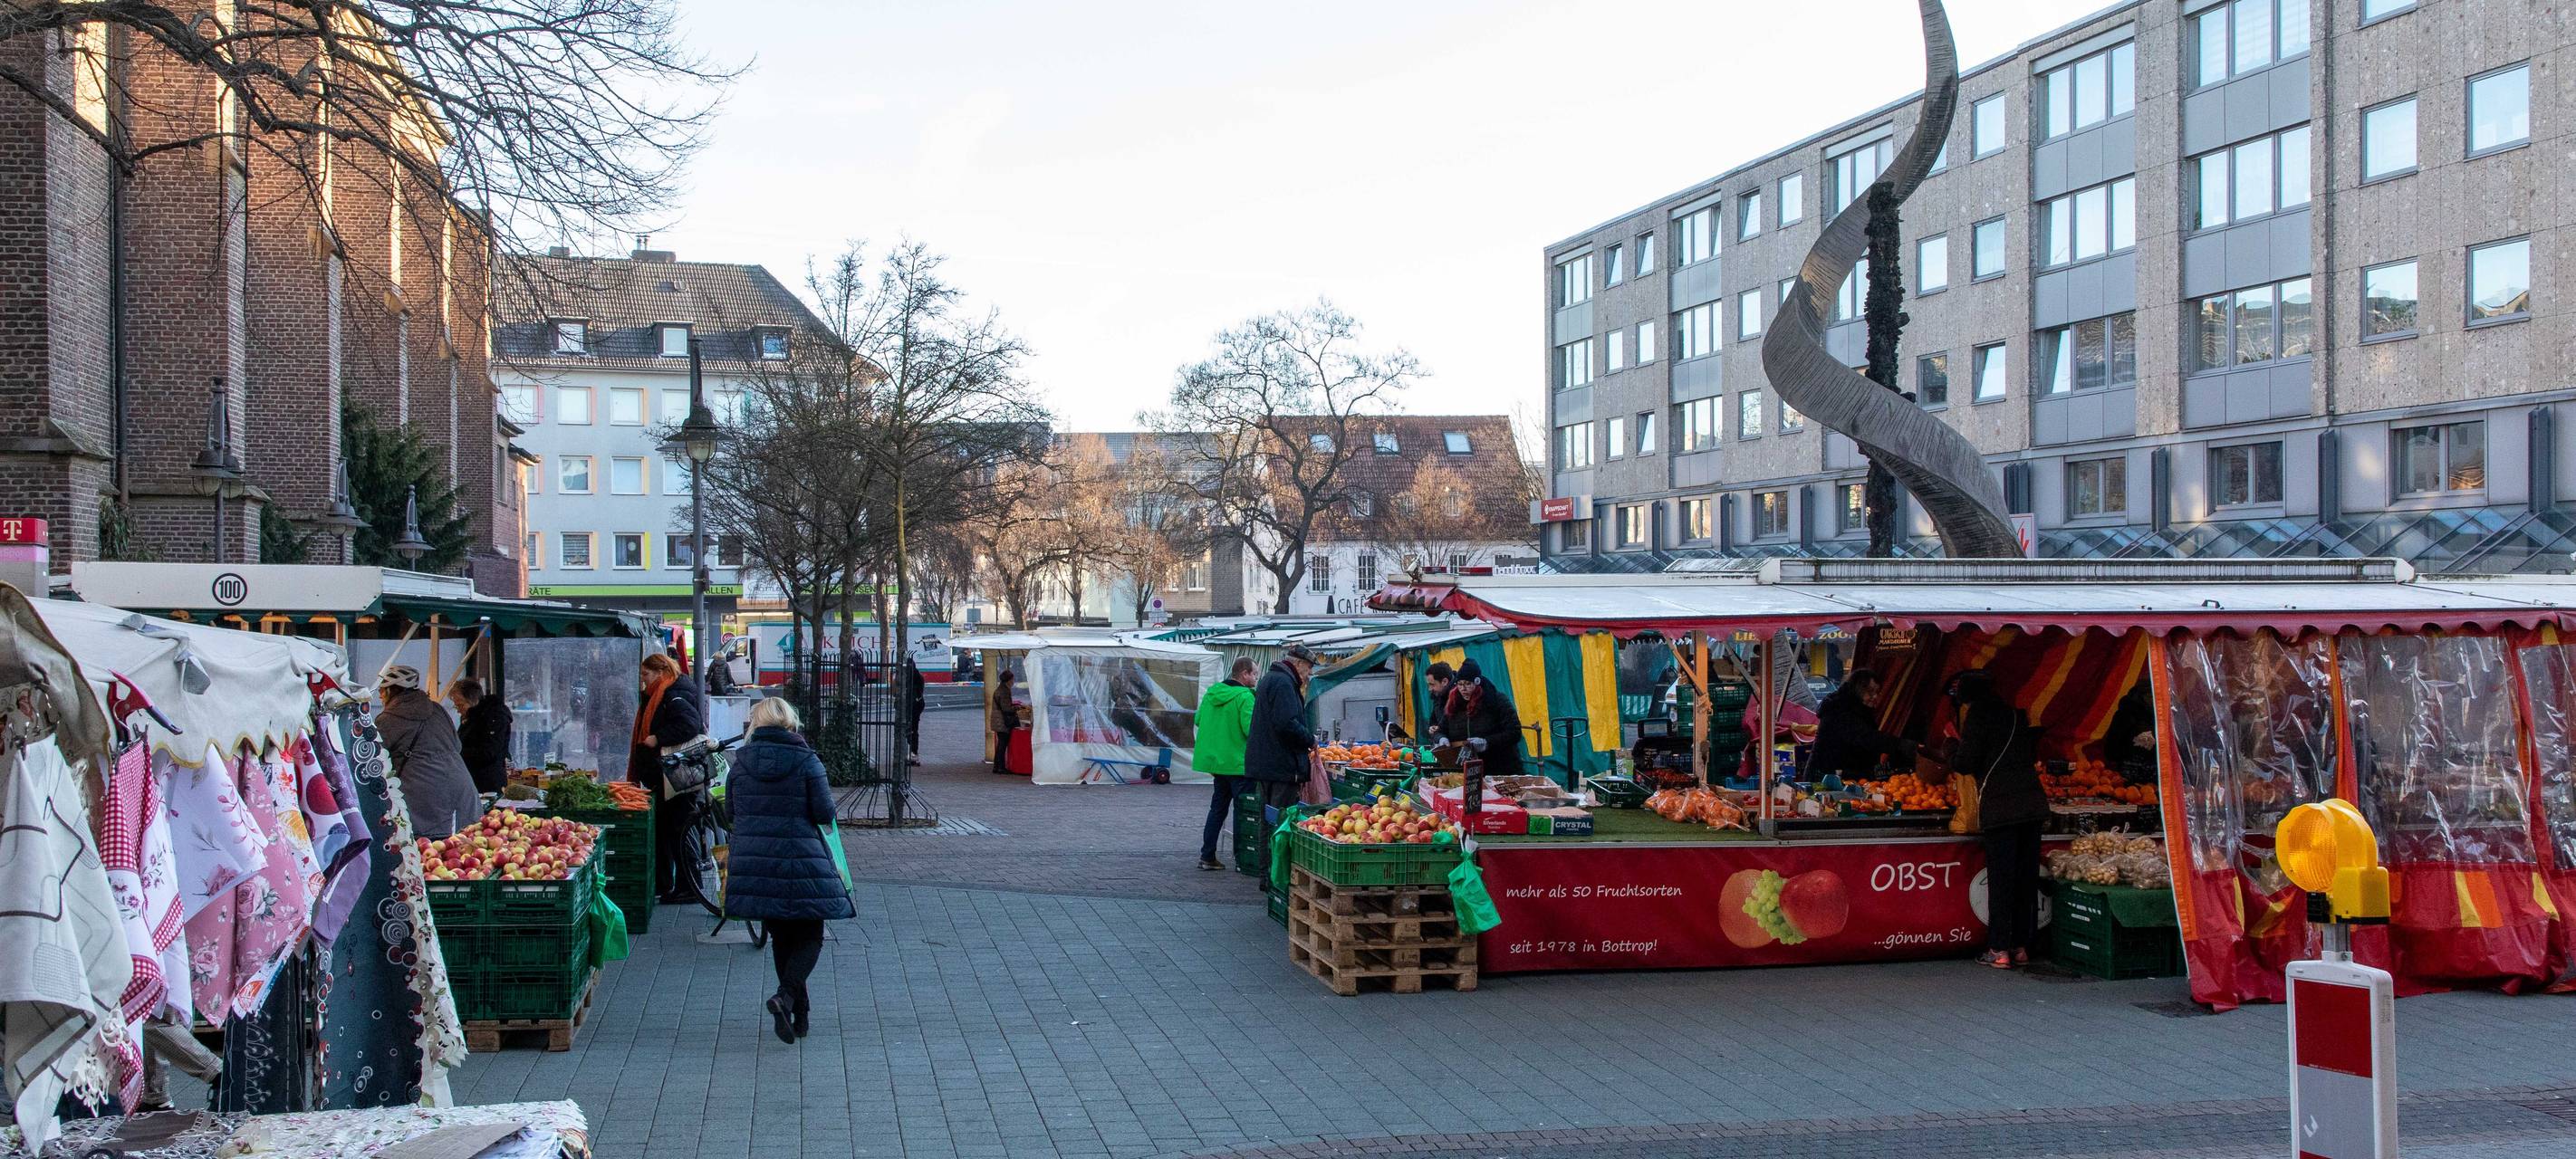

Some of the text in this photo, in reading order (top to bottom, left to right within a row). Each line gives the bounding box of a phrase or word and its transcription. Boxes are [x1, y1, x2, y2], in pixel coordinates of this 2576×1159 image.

[3, 520, 22, 541] T
[218, 580, 241, 599] 100
[1870, 861, 1961, 892] OBST
[1506, 884, 1683, 898] mehr als 50 Fruchtsorten
[1510, 939, 1658, 956] seit 1978 in Bottrop!
[1873, 926, 1972, 950] ...gönnen Sie
